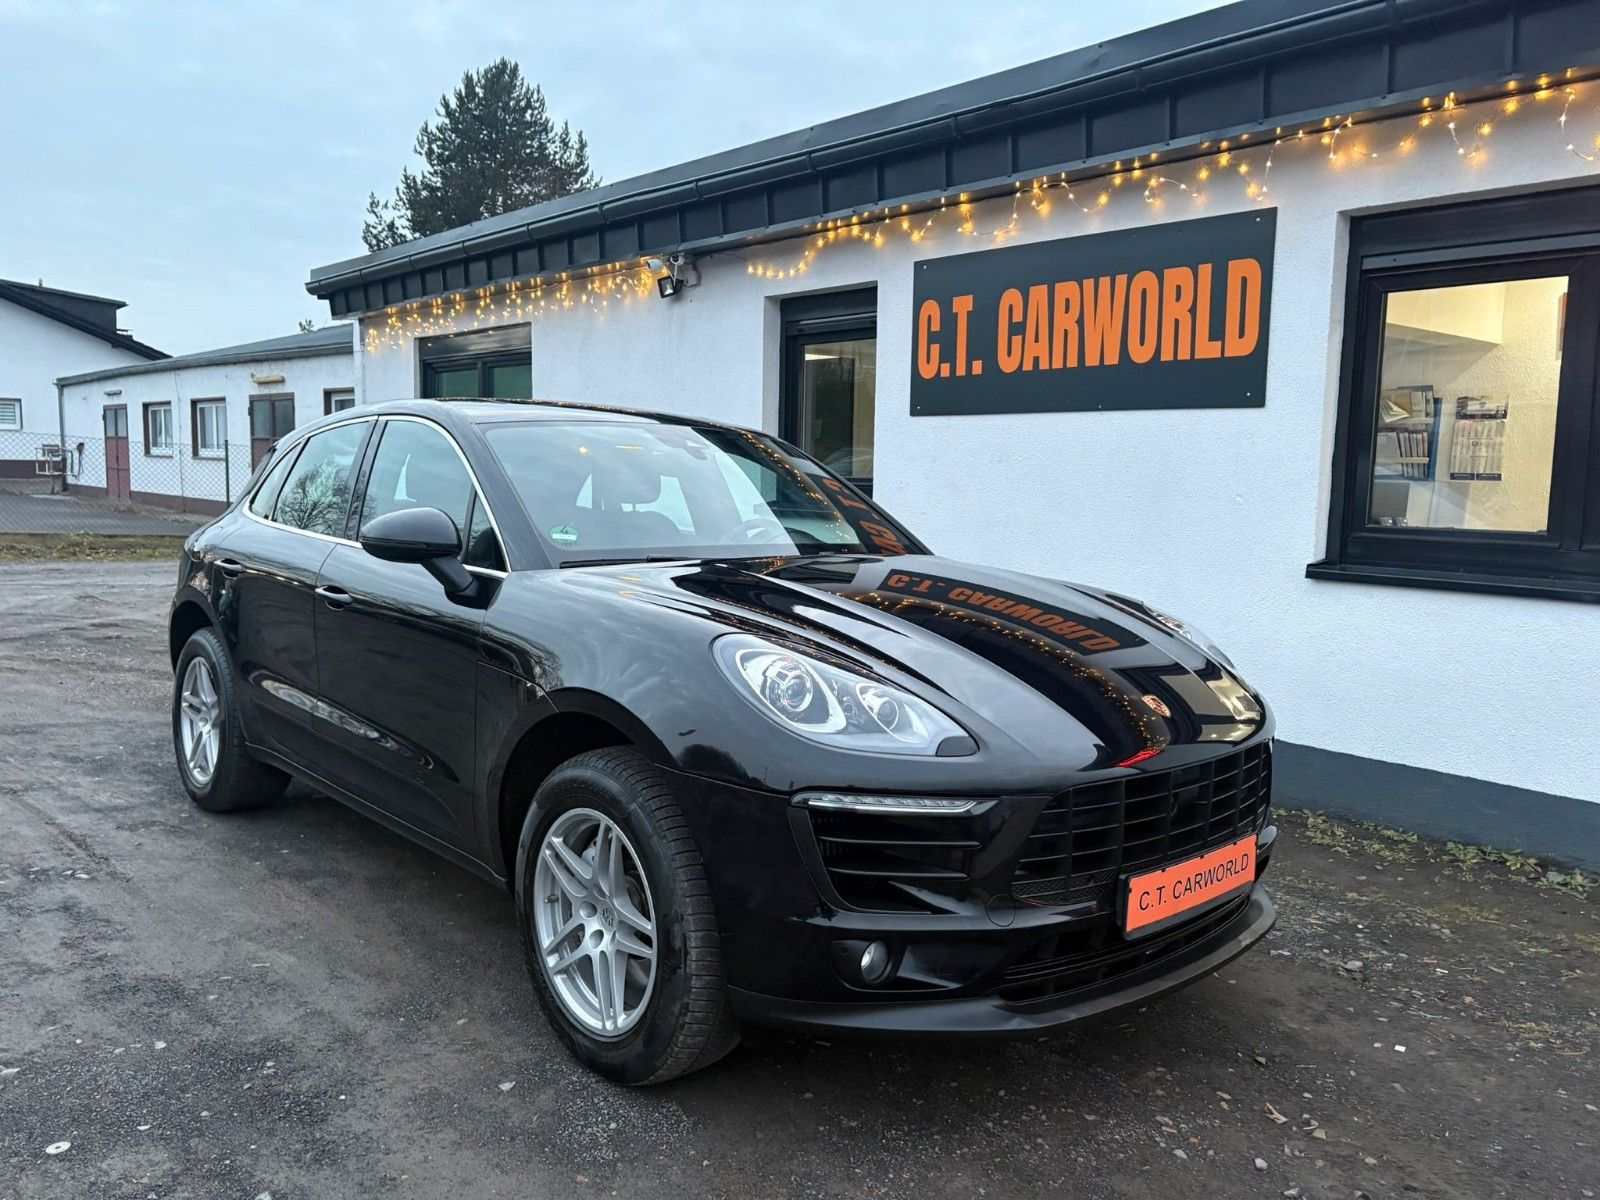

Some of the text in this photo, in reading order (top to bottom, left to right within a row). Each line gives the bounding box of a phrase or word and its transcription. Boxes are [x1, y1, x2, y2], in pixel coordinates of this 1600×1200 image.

[917, 258, 1262, 380] C.T. CARWORLD
[1139, 853, 1249, 911] C.T. CARWORLD
